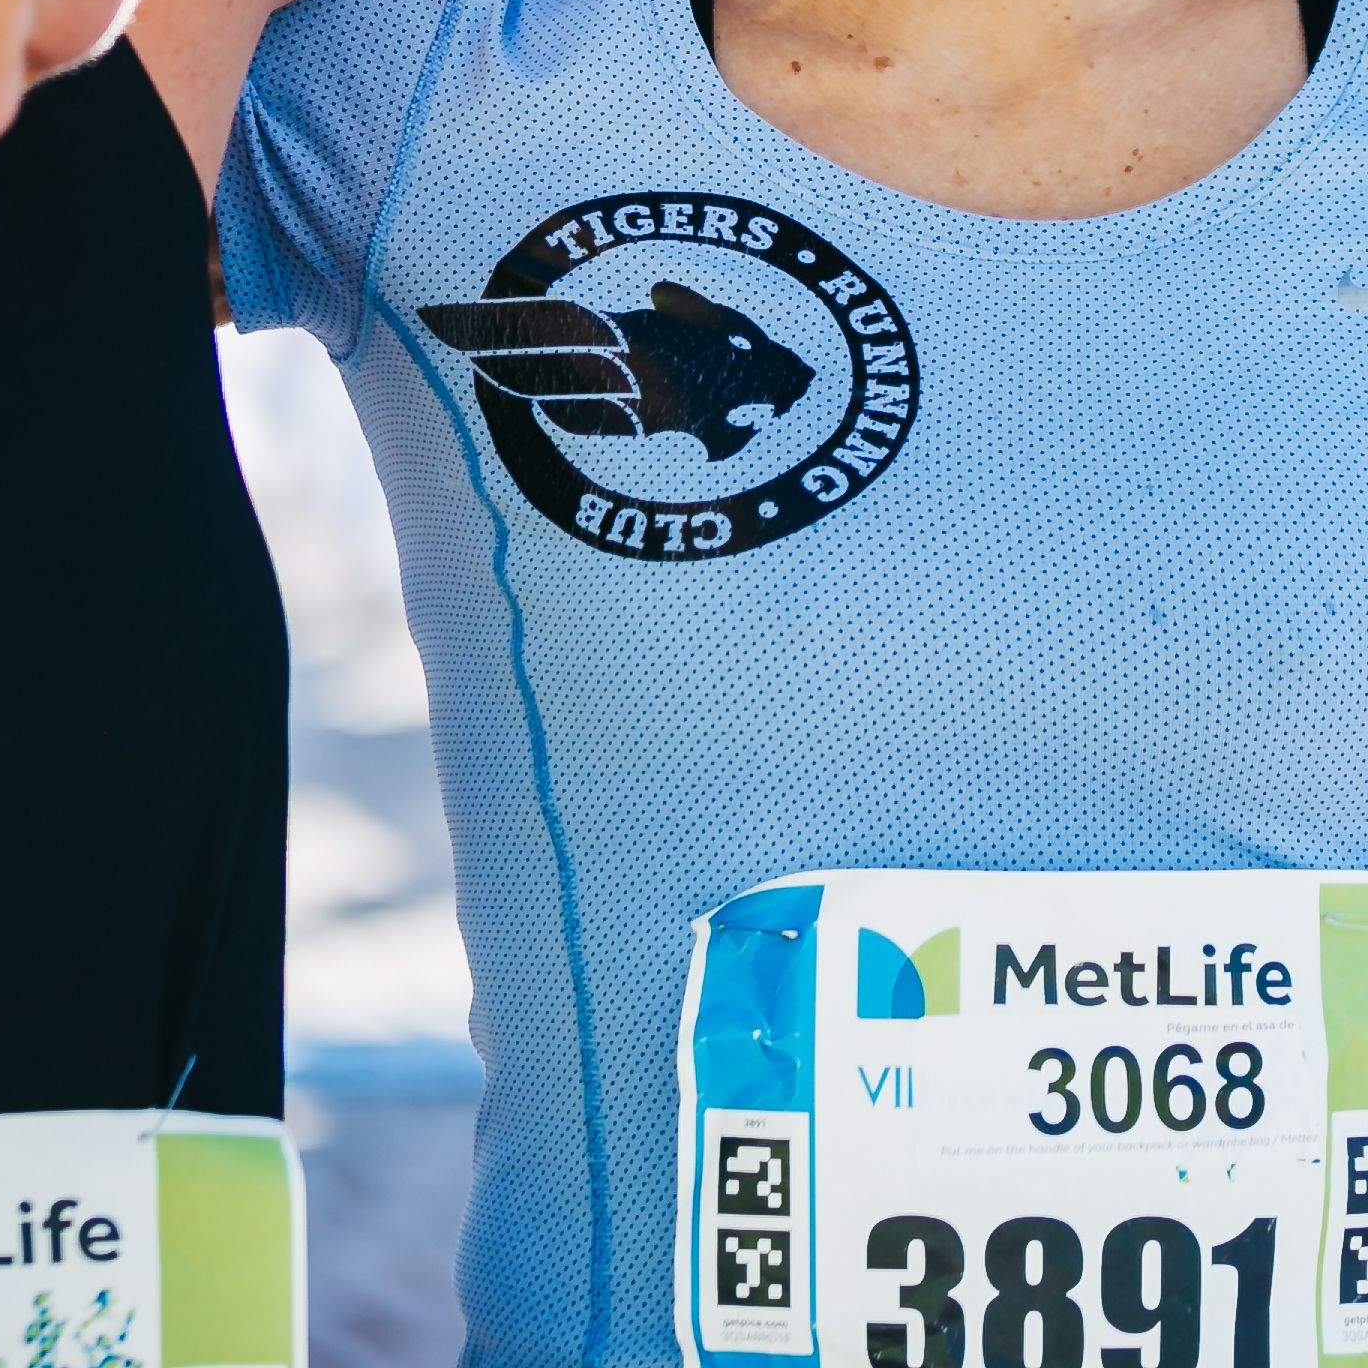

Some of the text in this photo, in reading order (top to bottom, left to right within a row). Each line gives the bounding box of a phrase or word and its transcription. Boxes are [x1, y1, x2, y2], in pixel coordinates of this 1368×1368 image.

[545, 202, 779, 260] TIGERS
[800, 271, 912, 504] RUNNING
[575, 492, 733, 552] CLUB
[993, 941, 1294, 1008] MetLife
[857, 1064, 914, 1109] VII
[1028, 1041, 1266, 1136] 3068
[866, 1215, 1278, 1368] 3891
